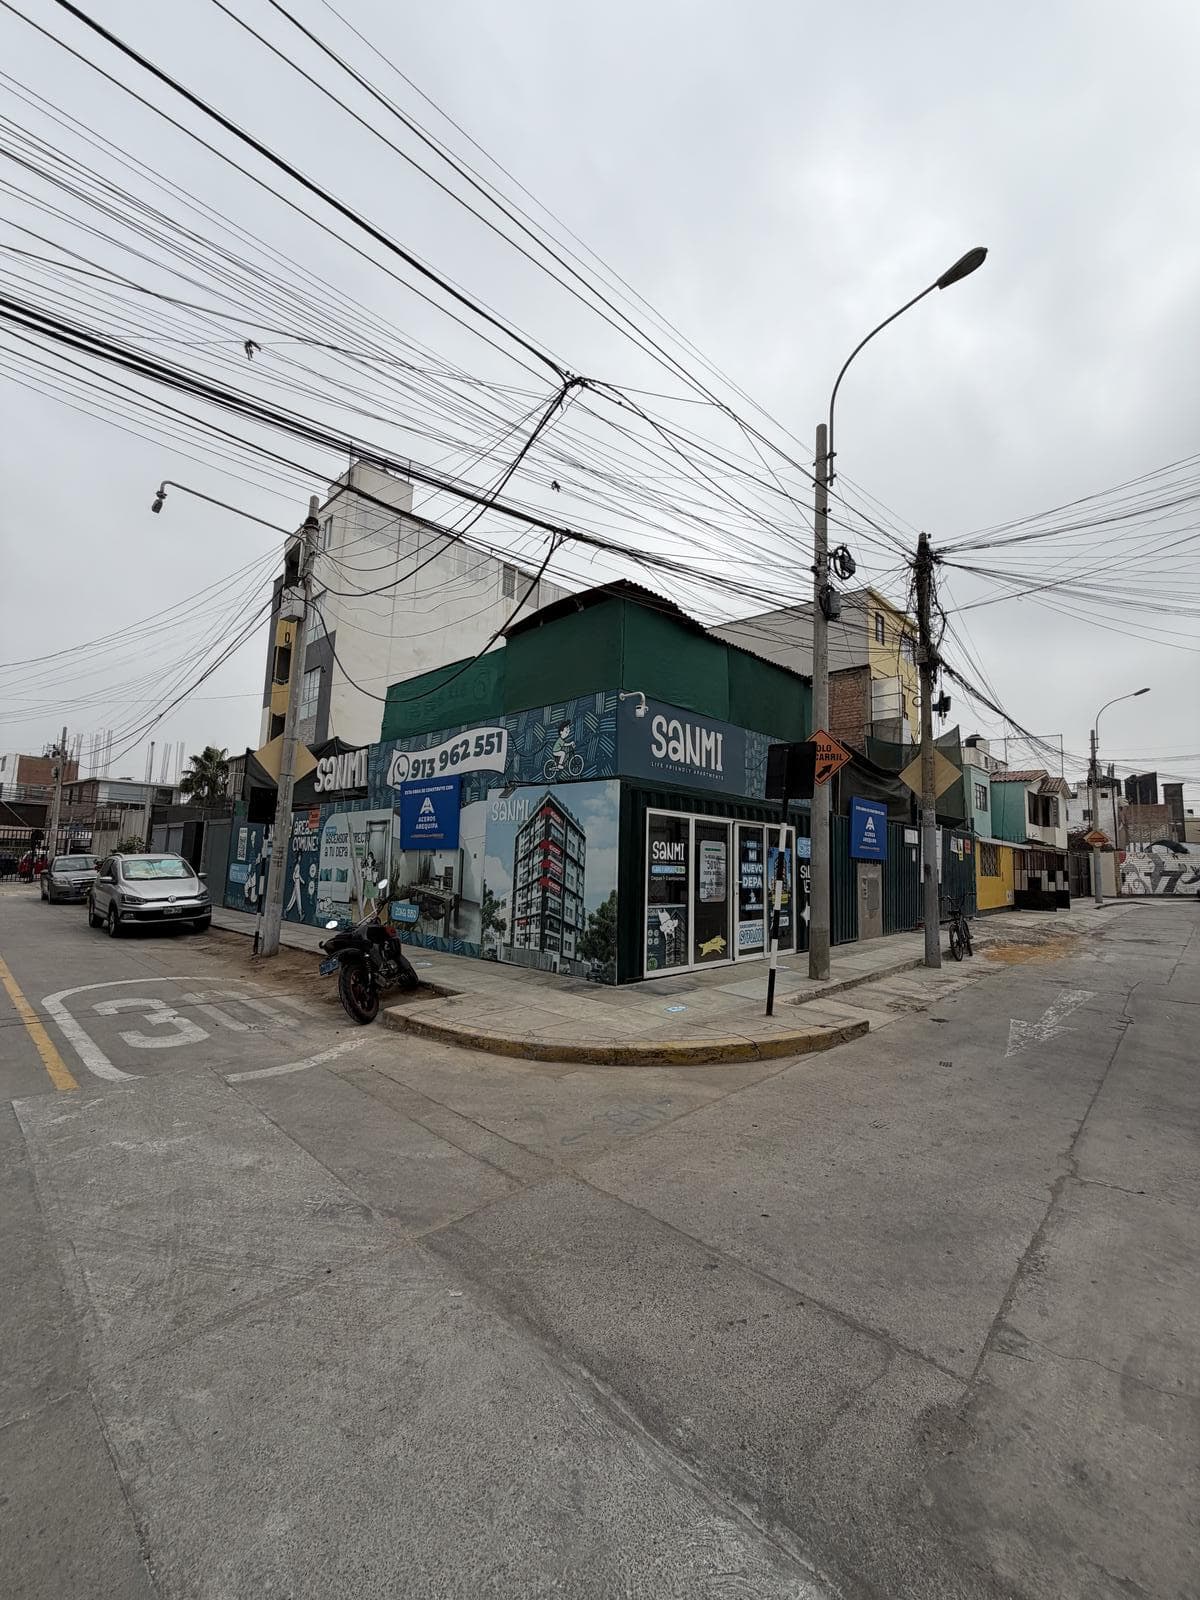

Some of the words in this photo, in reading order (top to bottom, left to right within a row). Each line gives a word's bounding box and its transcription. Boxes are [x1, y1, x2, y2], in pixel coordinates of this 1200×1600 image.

[816, 744, 832, 753] OLO
[411, 757, 436, 779] 913
[438, 739, 471, 771] 962
[472, 731, 504, 757] 551
[665, 763, 692, 774] FRIENDLY
[692, 769, 725, 782] APARTMENTS
[417, 815, 436, 823] ACEROS
[415, 822, 438, 831] AREQUIPA
[748, 849, 758, 862] MI
[741, 863, 763, 875] NUEVO
[741, 875, 763, 889] DEPA
